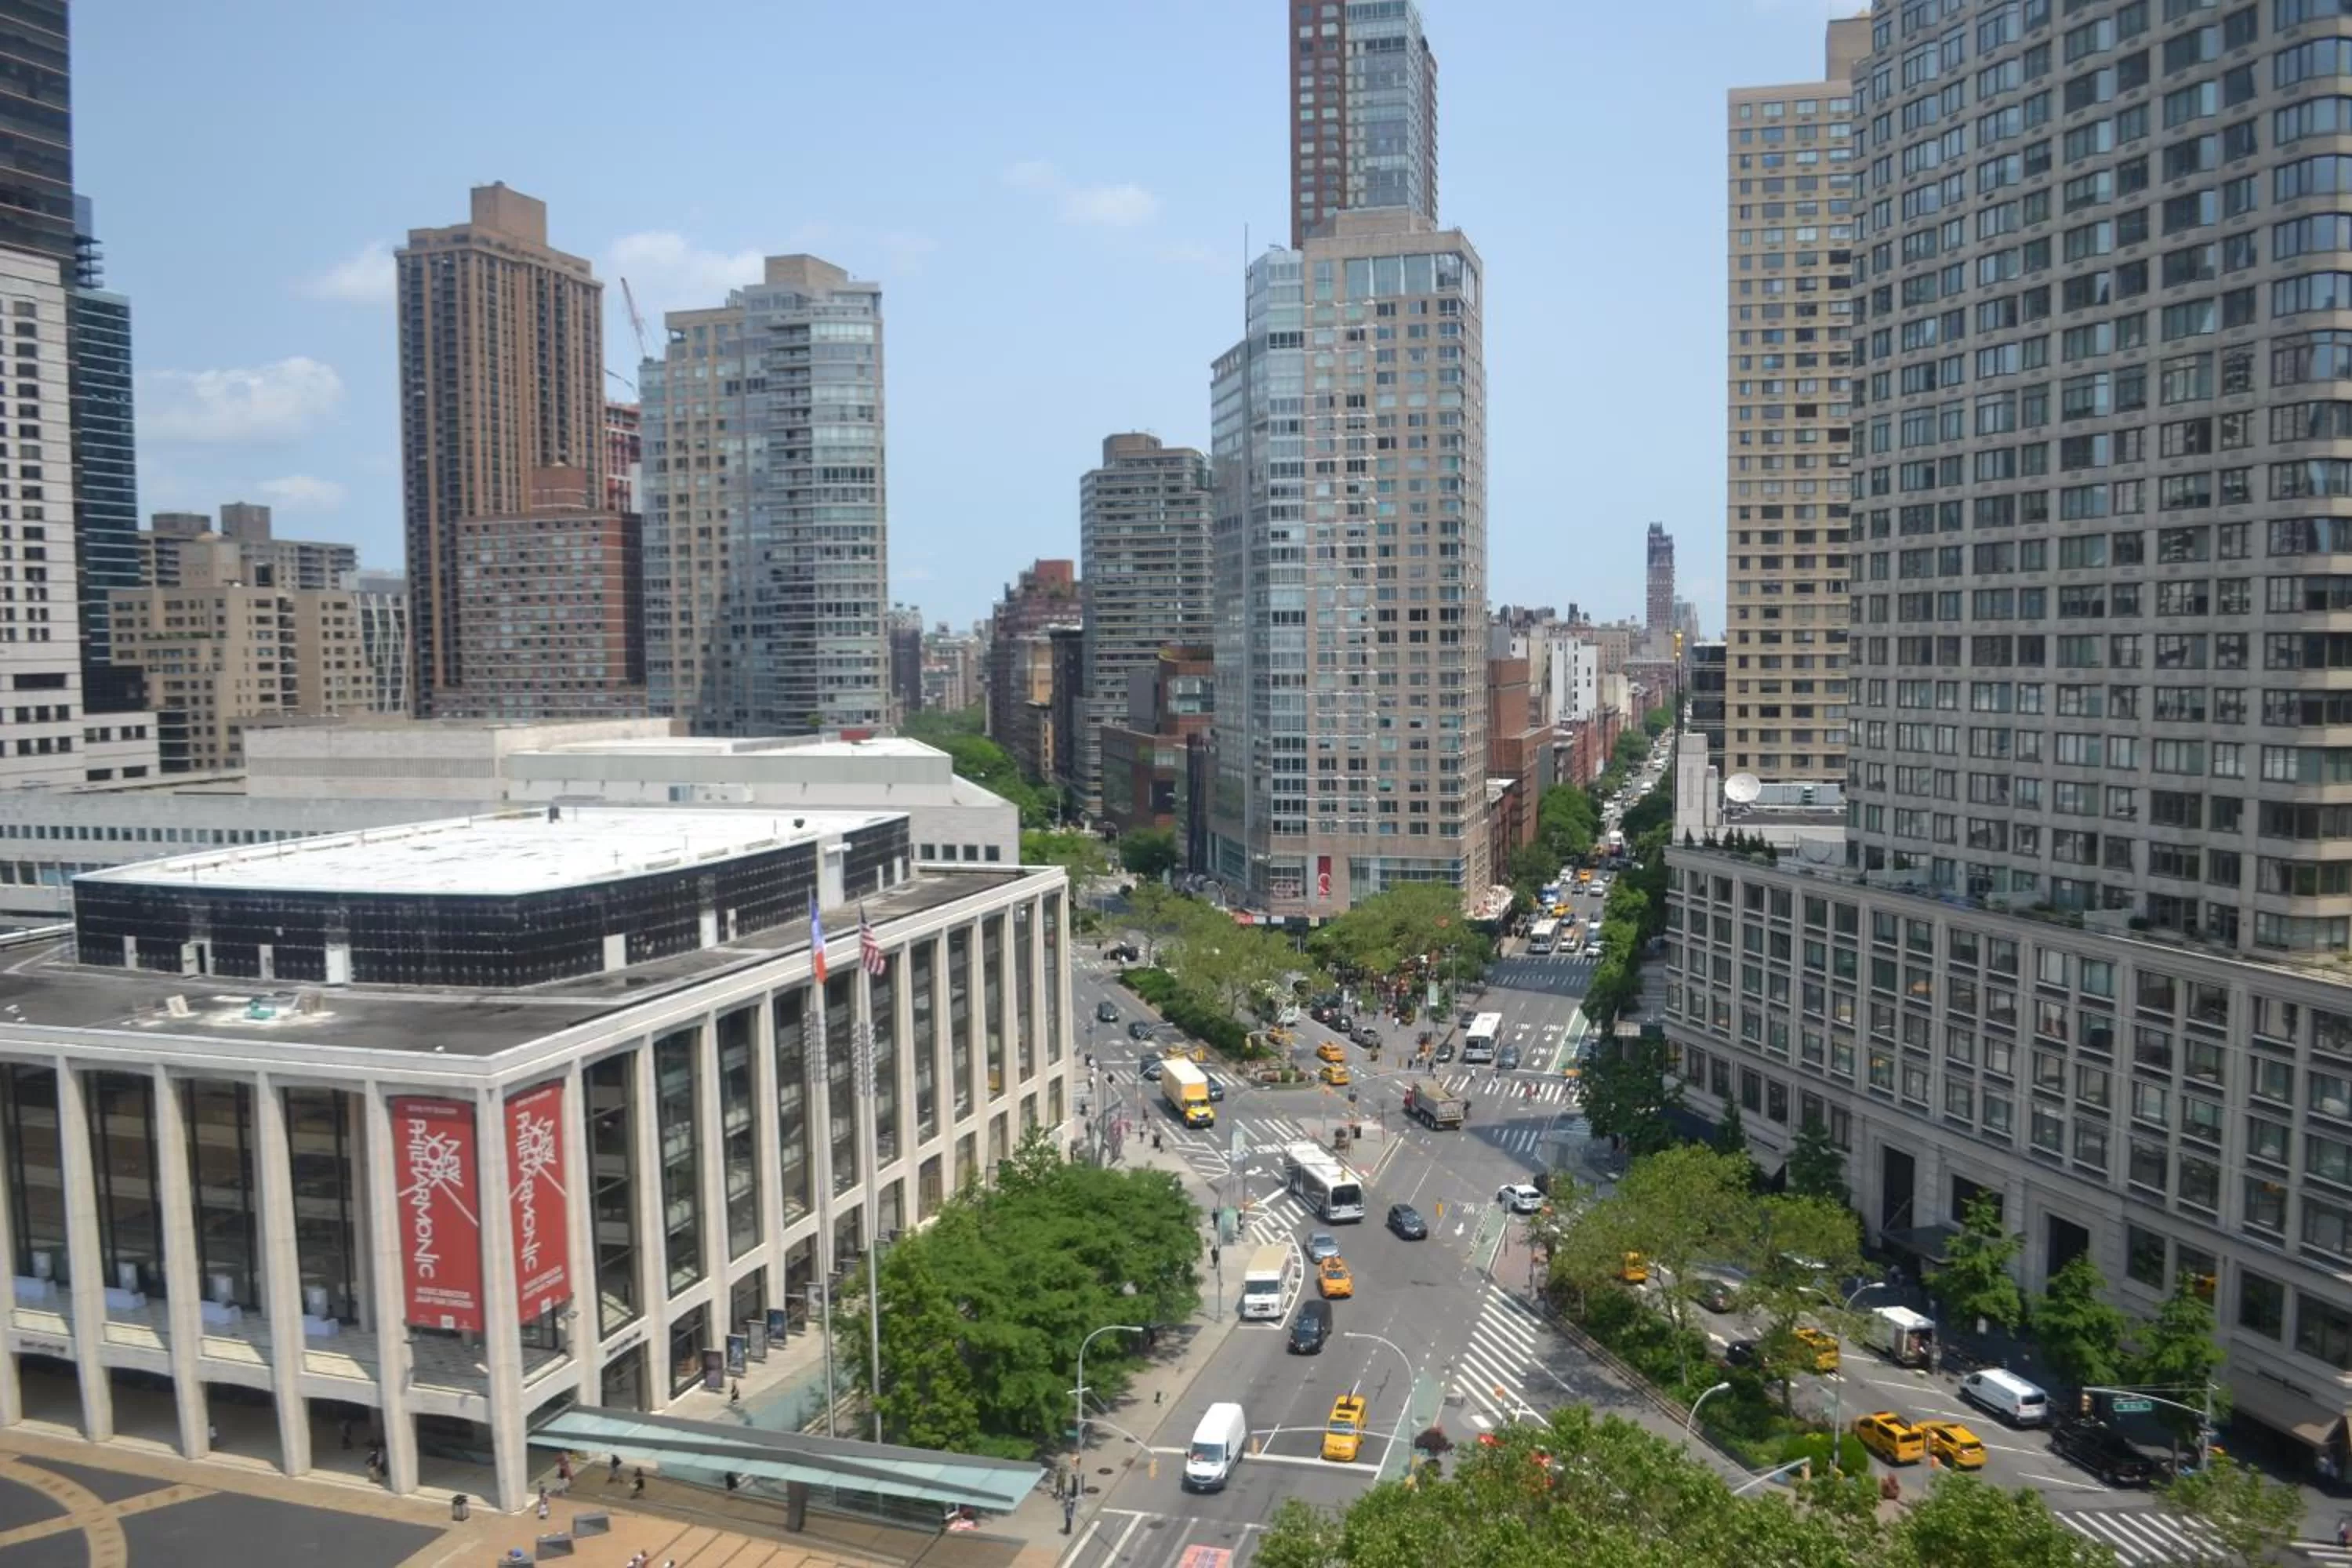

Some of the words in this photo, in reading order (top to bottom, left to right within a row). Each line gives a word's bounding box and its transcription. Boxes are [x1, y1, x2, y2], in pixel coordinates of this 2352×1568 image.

[441, 1139, 465, 1188] NEW
[515, 1111, 542, 1273] PHILHARMONIC
[542, 1119, 557, 1164] NEW
[405, 1119, 441, 1279] PHILHARMONIC
